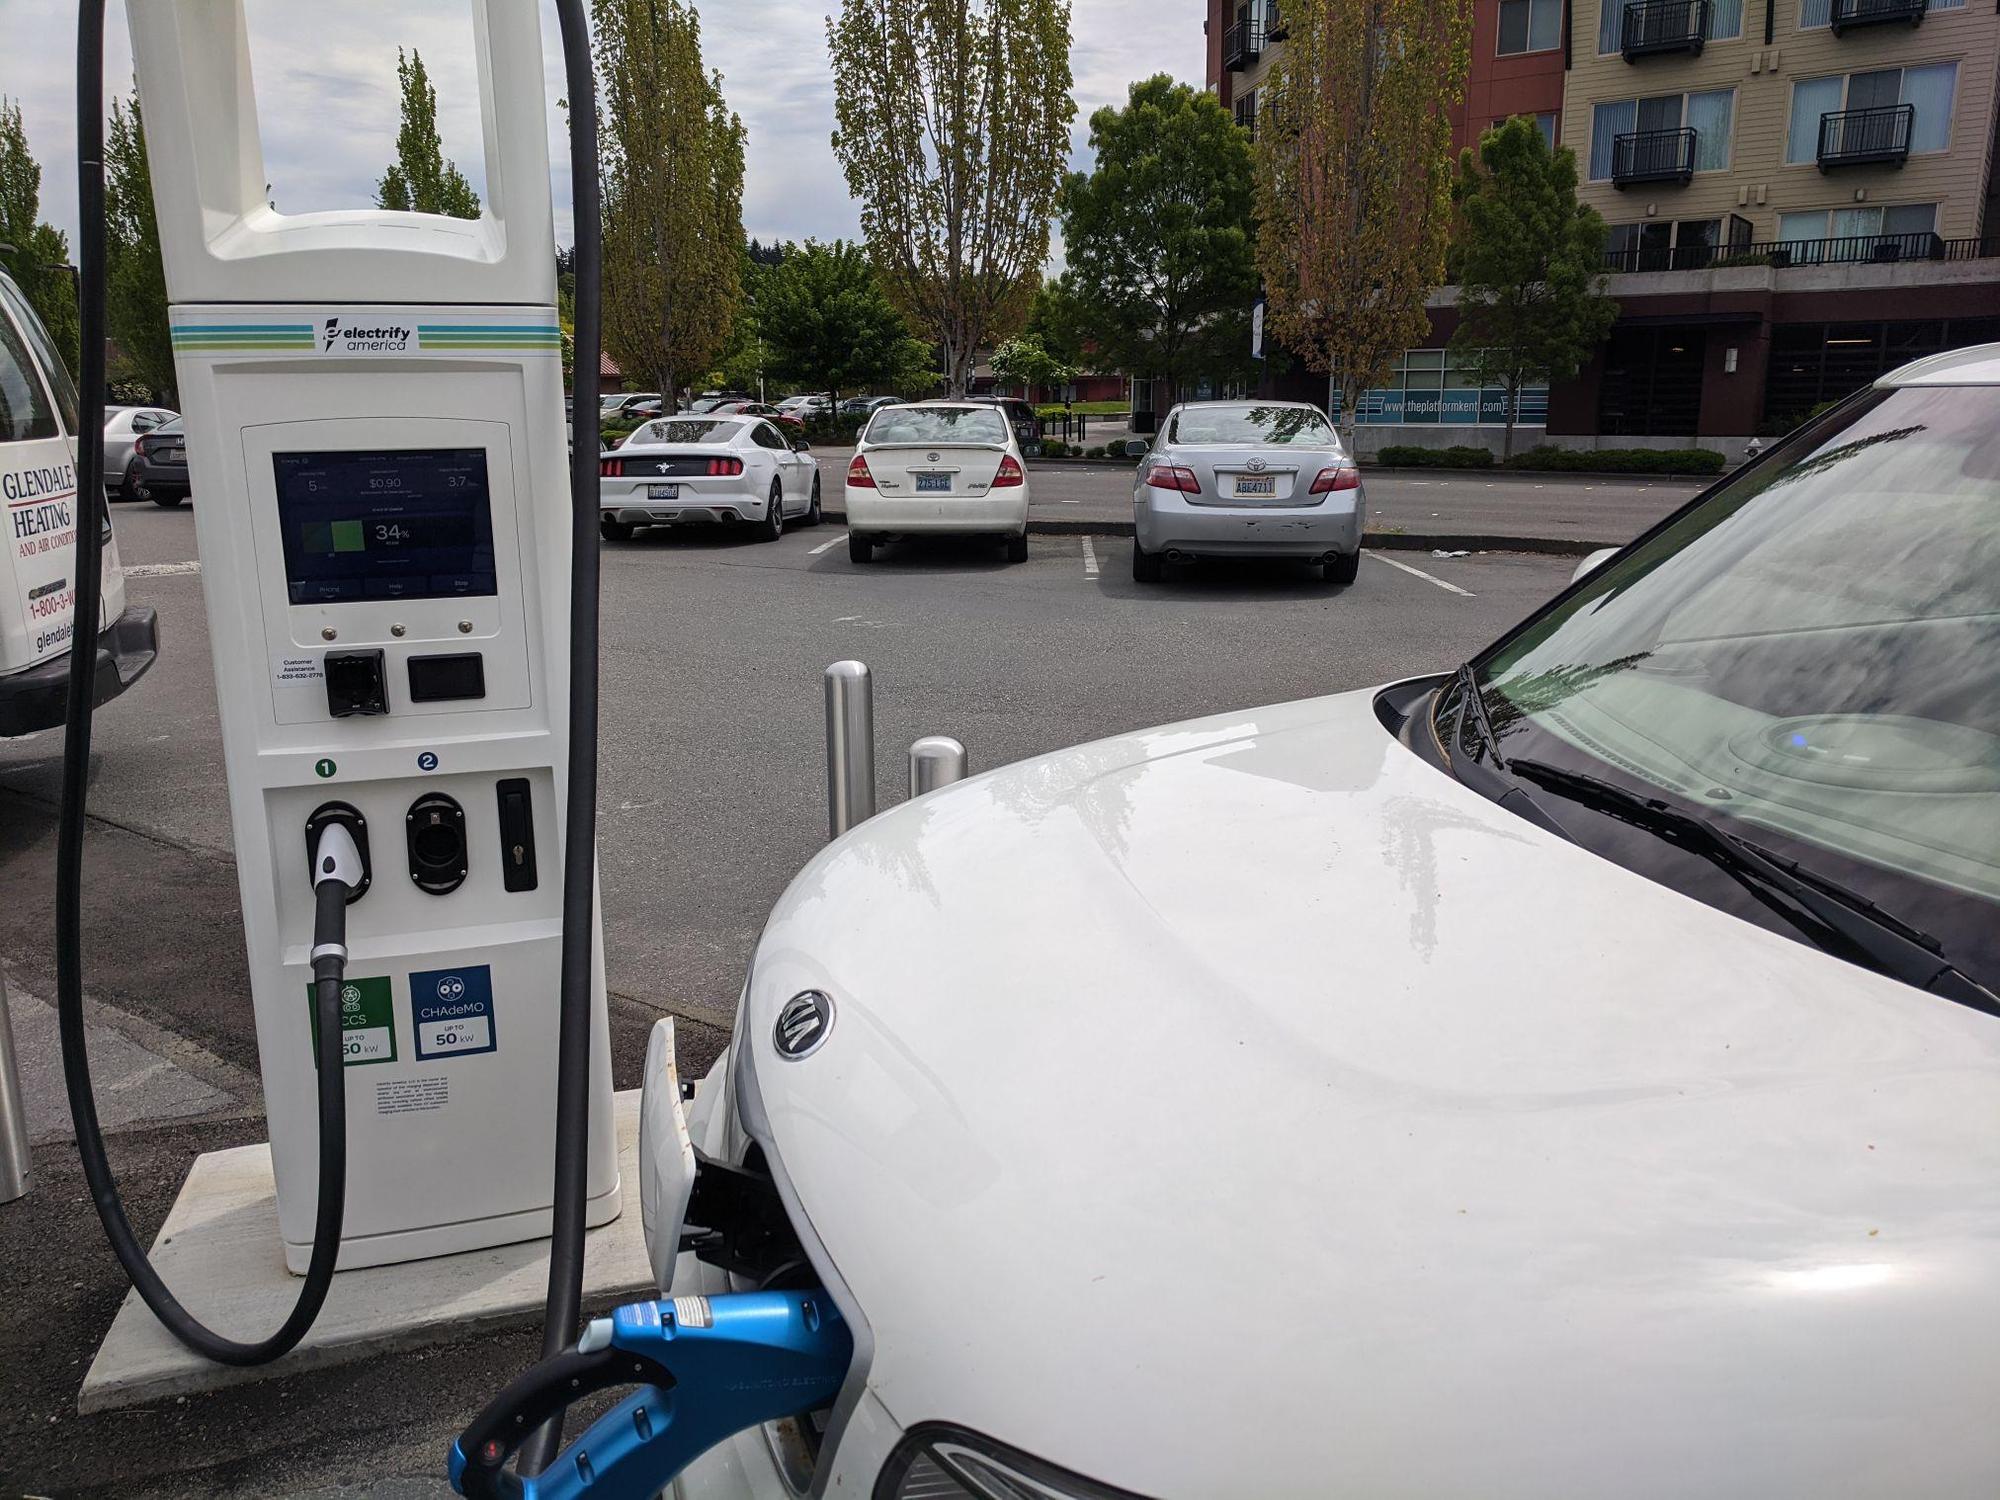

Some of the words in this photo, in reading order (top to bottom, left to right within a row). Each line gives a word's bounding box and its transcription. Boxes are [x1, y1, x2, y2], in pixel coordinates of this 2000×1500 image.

[343, 326, 410, 341] electrify
[347, 340, 406, 351] america
[1384, 400, 1502, 414] www.theplatformkent.com
[3, 465, 74, 500] GLENDALE
[308, 480, 318, 492] 5
[369, 478, 401, 489] $0.90
[448, 476, 466, 487] 3.7
[13, 502, 70, 538] HEATING
[19, 541, 37, 558] AND
[38, 537, 51, 553] AIR
[321, 761, 330, 775] 1
[422, 755, 435, 768] 2
[421, 1002, 484, 1018] CHAdeMO
[454, 1023, 464, 1031] TO
[436, 1033, 457, 1046] 50
[460, 1034, 474, 1043] kW
[343, 1042, 361, 1055] 50
[364, 1045, 379, 1053] kW
